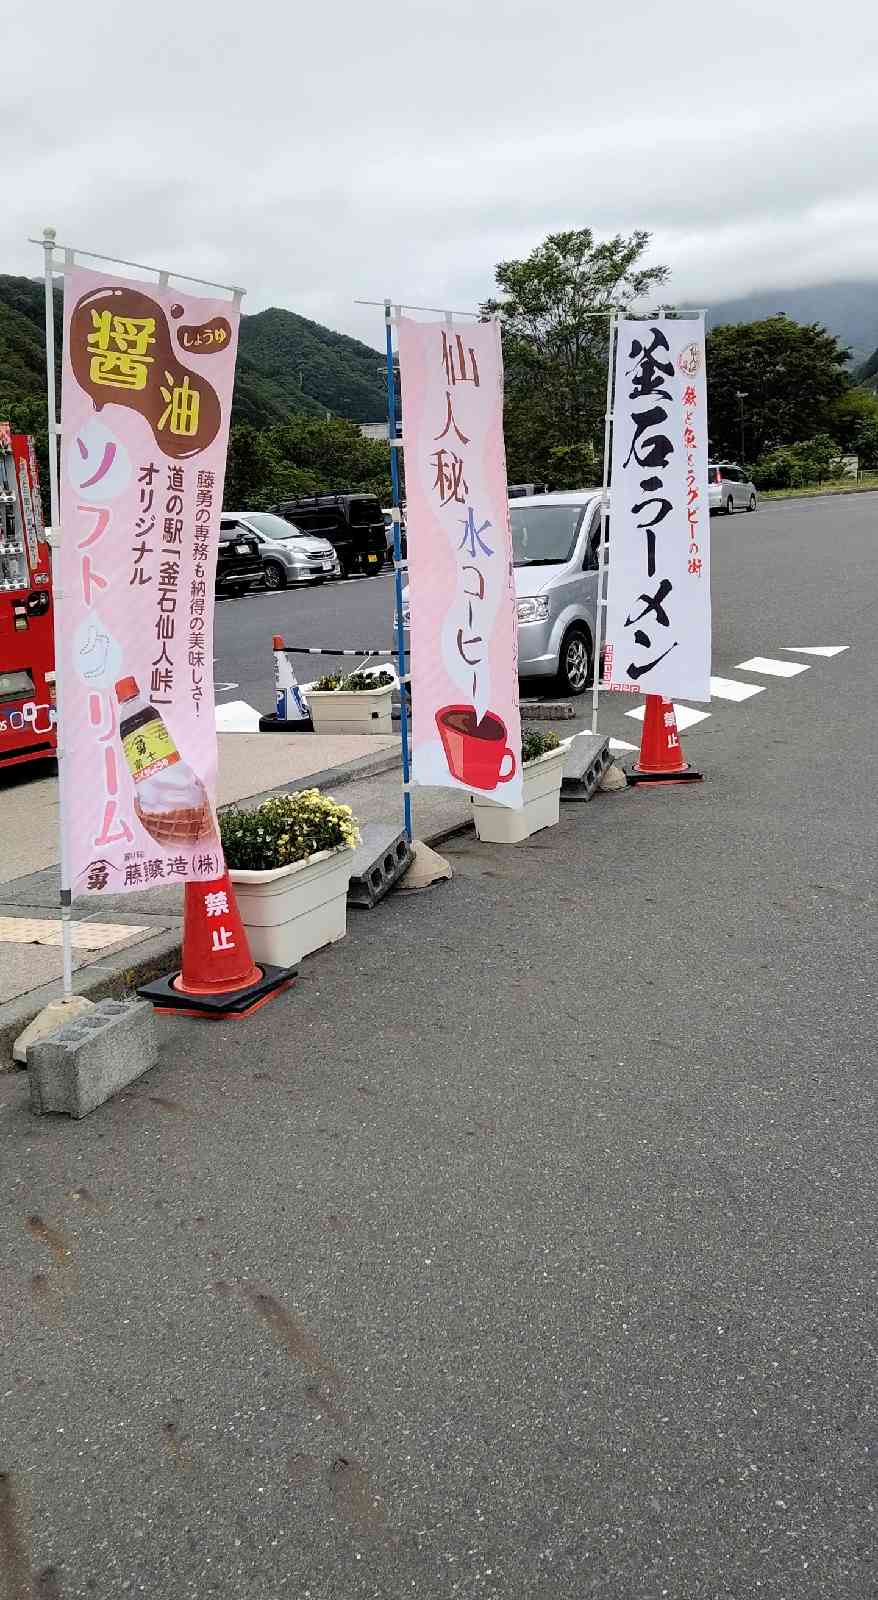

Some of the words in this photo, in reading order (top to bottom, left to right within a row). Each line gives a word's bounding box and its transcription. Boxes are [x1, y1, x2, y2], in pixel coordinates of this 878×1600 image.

[87, 308, 201, 436] 醤油
[130, 462, 161, 586] オリジナル
[430, 330, 495, 698] 仙人秘水コーヒー
[622, 327, 680, 680] 釜石ラーメン
[204, 890, 236, 952] 禁止
